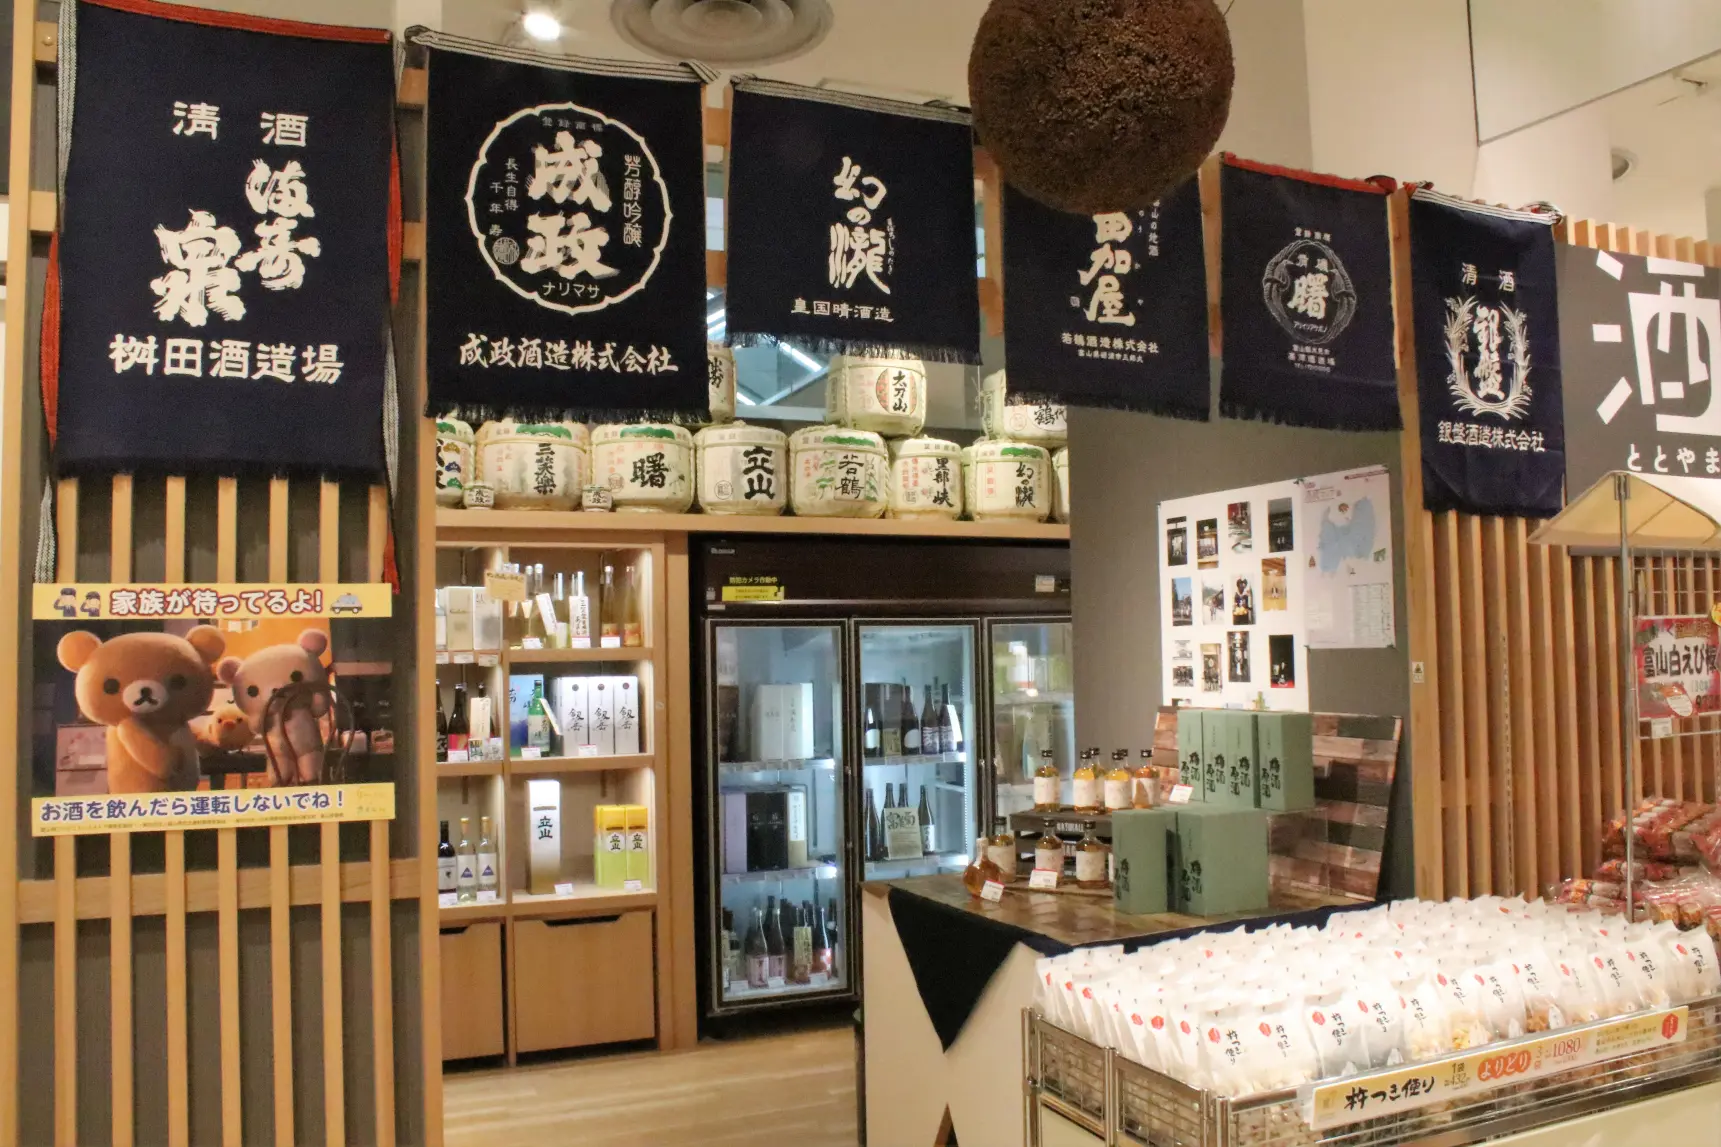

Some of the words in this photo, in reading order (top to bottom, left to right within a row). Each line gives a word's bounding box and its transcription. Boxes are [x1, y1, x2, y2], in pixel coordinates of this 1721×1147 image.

[172, 101, 309, 148] 清酒
[520, 130, 621, 280] 成政
[542, 281, 600, 299] ナリマサ
[1462, 262, 1516, 292] 清酒
[791, 297, 894, 323] 皇国晴酒造
[108, 333, 345, 386] 桝田酒造場
[459, 332, 679, 376] 成政酒造株式会社
[1592, 249, 1721, 437] 酒
[892, 370, 908, 412] 太刀山
[1437, 420, 1546, 453] 銀盤酒造株式会社
[630, 452, 669, 488] 曙
[743, 446, 775, 500] 立山
[1627, 443, 1720, 473] ととやま
[834, 454, 864, 499] 若鶴
[538, 815, 553, 840] 立山
[610, 834, 621, 851] 立山
[632, 833, 643, 850] 立山
[1480, 1052, 1529, 1078] よりどり
[1344, 1076, 1435, 1110] 杵つき便り
